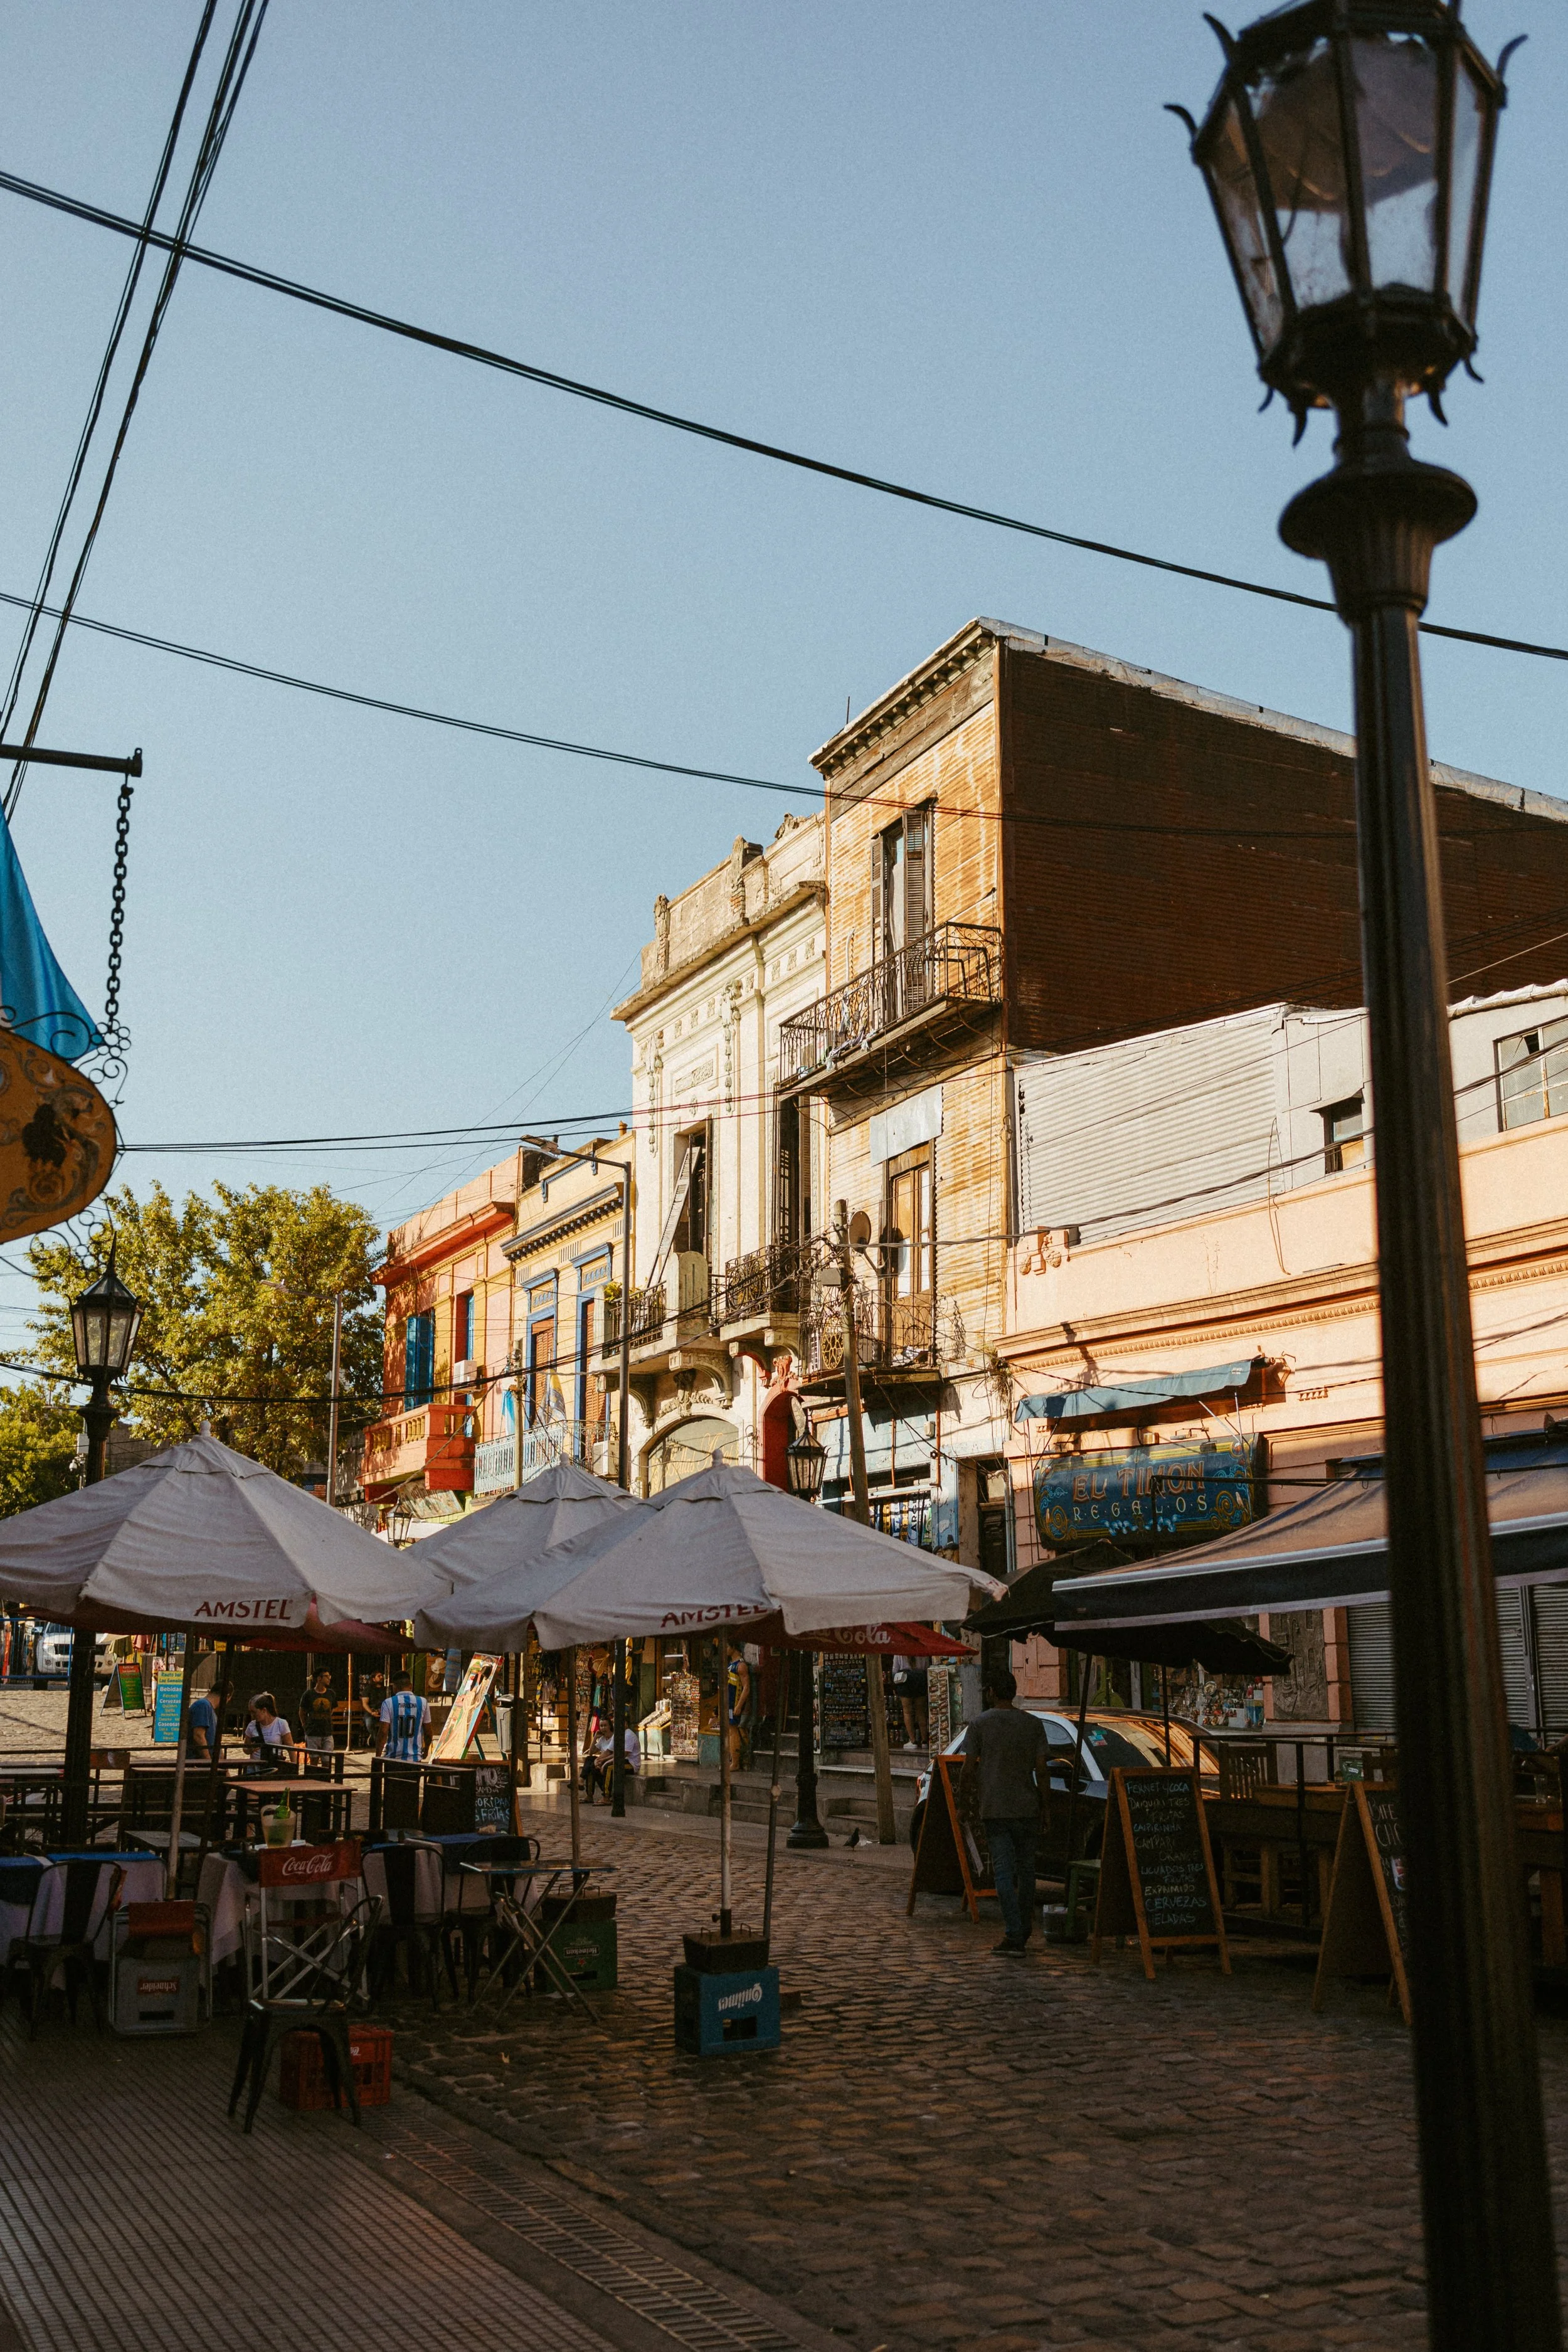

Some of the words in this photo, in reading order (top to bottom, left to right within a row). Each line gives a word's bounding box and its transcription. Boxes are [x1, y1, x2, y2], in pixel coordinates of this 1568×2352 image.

[1073, 1472, 1108, 1503] EL
[1117, 1460, 1205, 1498] TIMON
[194, 1599, 291, 1619] AMSTEL
[660, 1603, 767, 1628] AMSTEL
[398, 1714, 416, 1739] 10
[1125, 1781, 1159, 1793] FERNET
[1169, 1783, 1189, 1792] COCA
[1145, 1896, 1207, 1911] CERVEZAS
[566, 1947, 597, 1955] Heineken
[140, 1982, 177, 1993] Schneider
[718, 1982, 763, 2011] Quilmes
